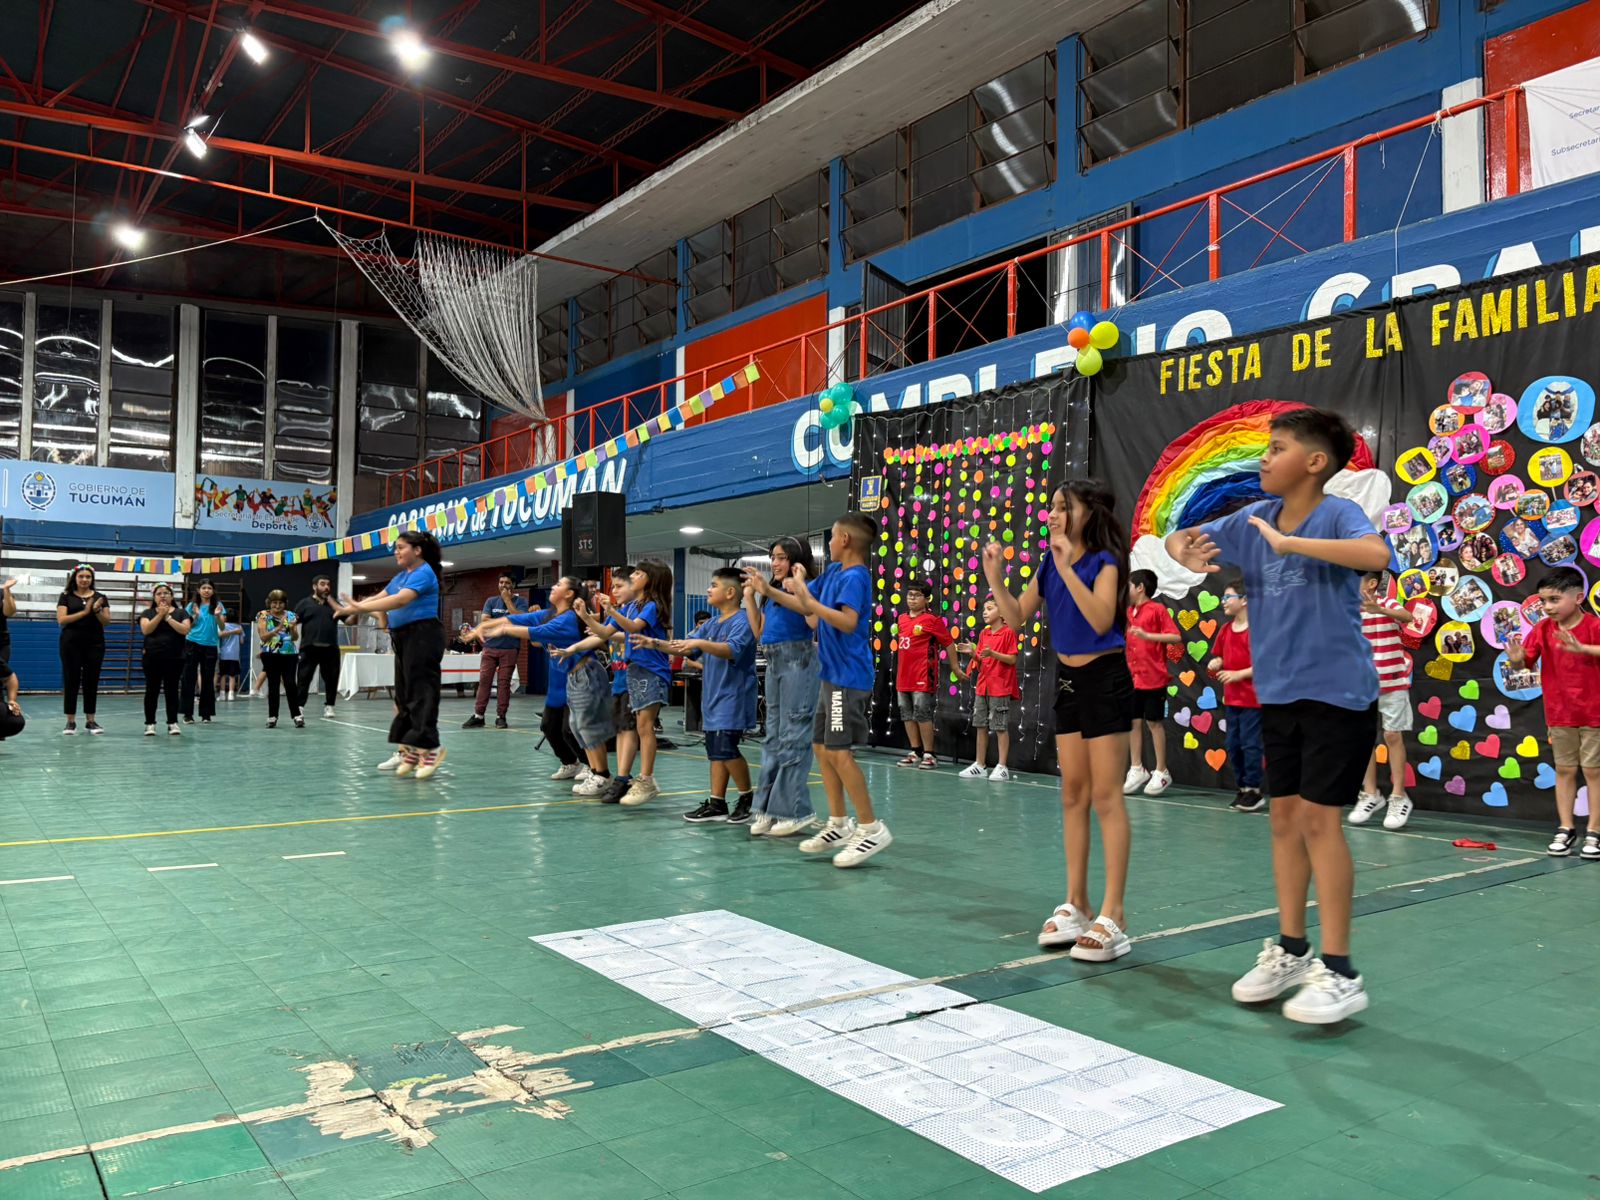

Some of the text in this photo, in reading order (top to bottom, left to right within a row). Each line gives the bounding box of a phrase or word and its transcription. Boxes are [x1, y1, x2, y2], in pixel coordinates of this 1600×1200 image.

[1159, 342, 1263, 395] FIESTA
[1292, 327, 1332, 372] DE
[1365, 311, 1404, 359] LA
[1431, 262, 1600, 347] FAMILIA
[69, 482, 145, 495] GOBIERNO DE
[69, 493, 145, 507] TUCUMÁN
[251, 520, 298, 532] Deportes
[578, 539, 593, 550] STS
[898, 636, 910, 650] 23
[831, 690, 844, 732] MARINE
